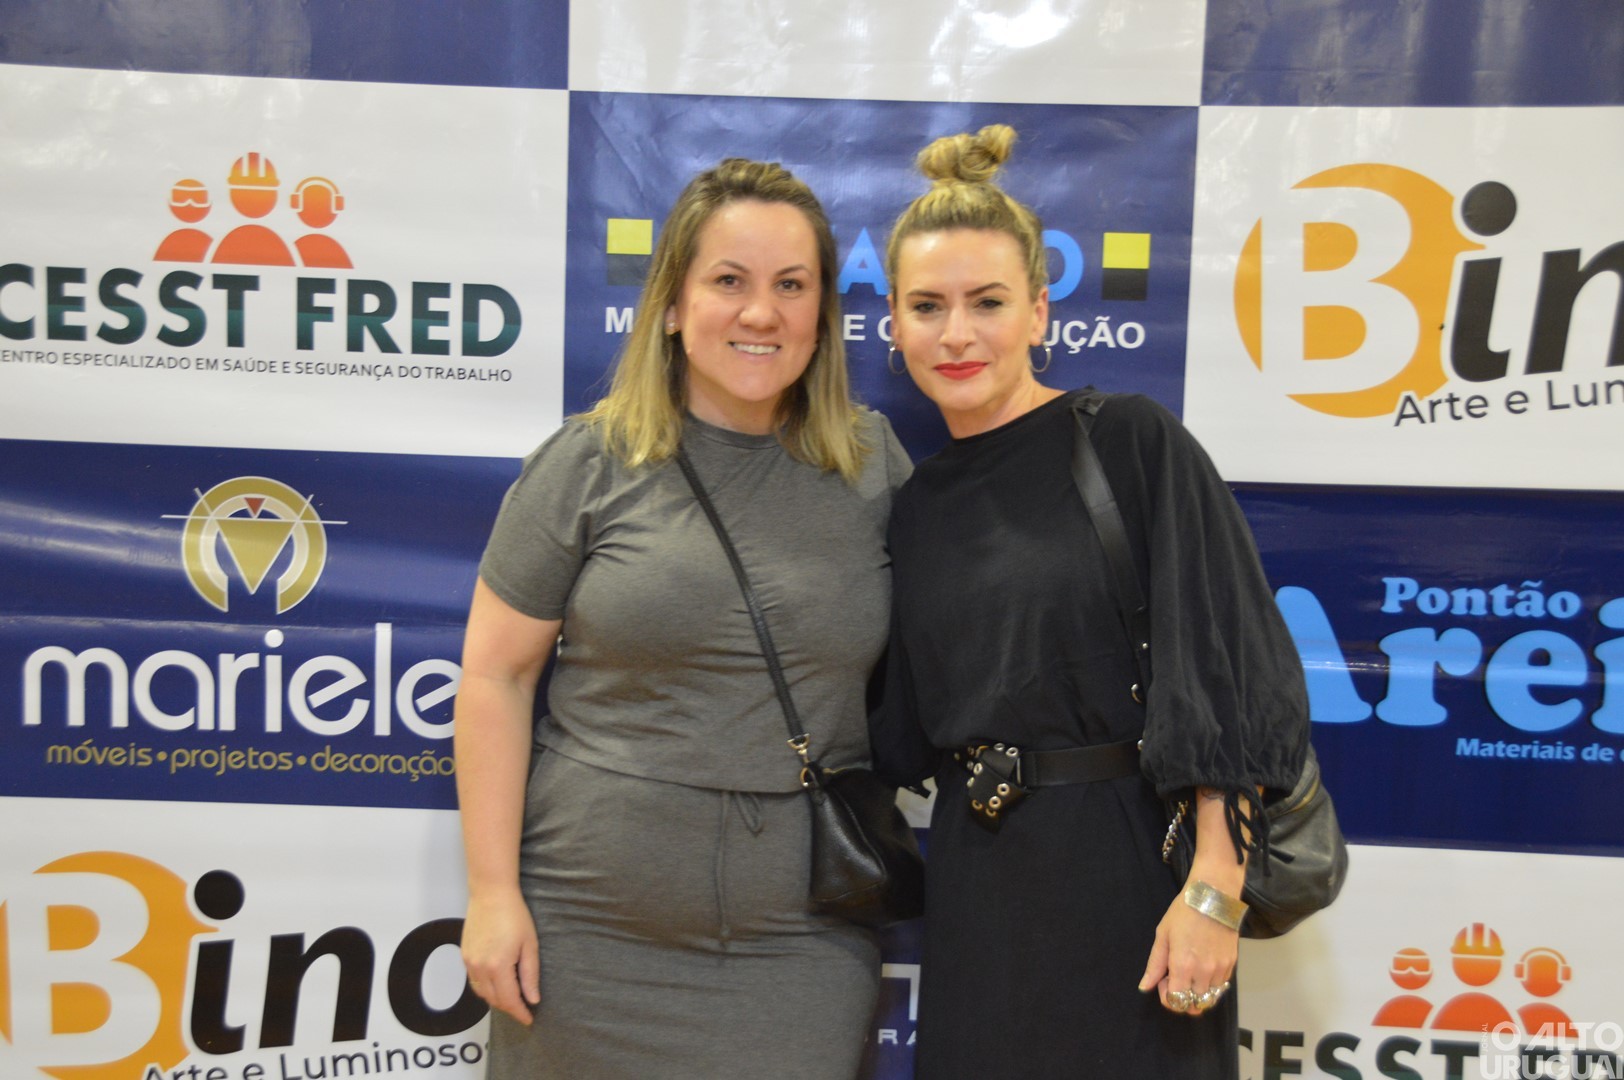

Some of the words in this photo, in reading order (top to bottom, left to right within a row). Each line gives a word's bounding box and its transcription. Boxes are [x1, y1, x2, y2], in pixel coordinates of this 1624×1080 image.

[0, 263, 261, 348] CESST
[296, 276, 523, 358] FRED
[843, 314, 866, 341] E
[0, 349, 58, 365] ENTRO
[63, 352, 191, 370] ESPECIALIZADO
[195, 358, 219, 371] EM
[223, 357, 277, 374] SAÚDE
[282, 360, 291, 374] E
[295, 361, 394, 381] SEGURANÇA
[398, 365, 422, 379] DO
[424, 366, 512, 382] TRABALHO
[1394, 392, 1489, 427] Arte
[1505, 390, 1529, 415] e
[1380, 577, 1582, 619] Pontão
[22, 622, 462, 740] mariele
[46, 738, 153, 766] móveis
[170, 745, 293, 776] projetos
[310, 744, 456, 782] decoração
[1455, 738, 1576, 761] Materiais
[1581, 743, 1615, 763] de
[7, 868, 492, 1067] Bino
[280, 1041, 488, 1080] Luminoso
